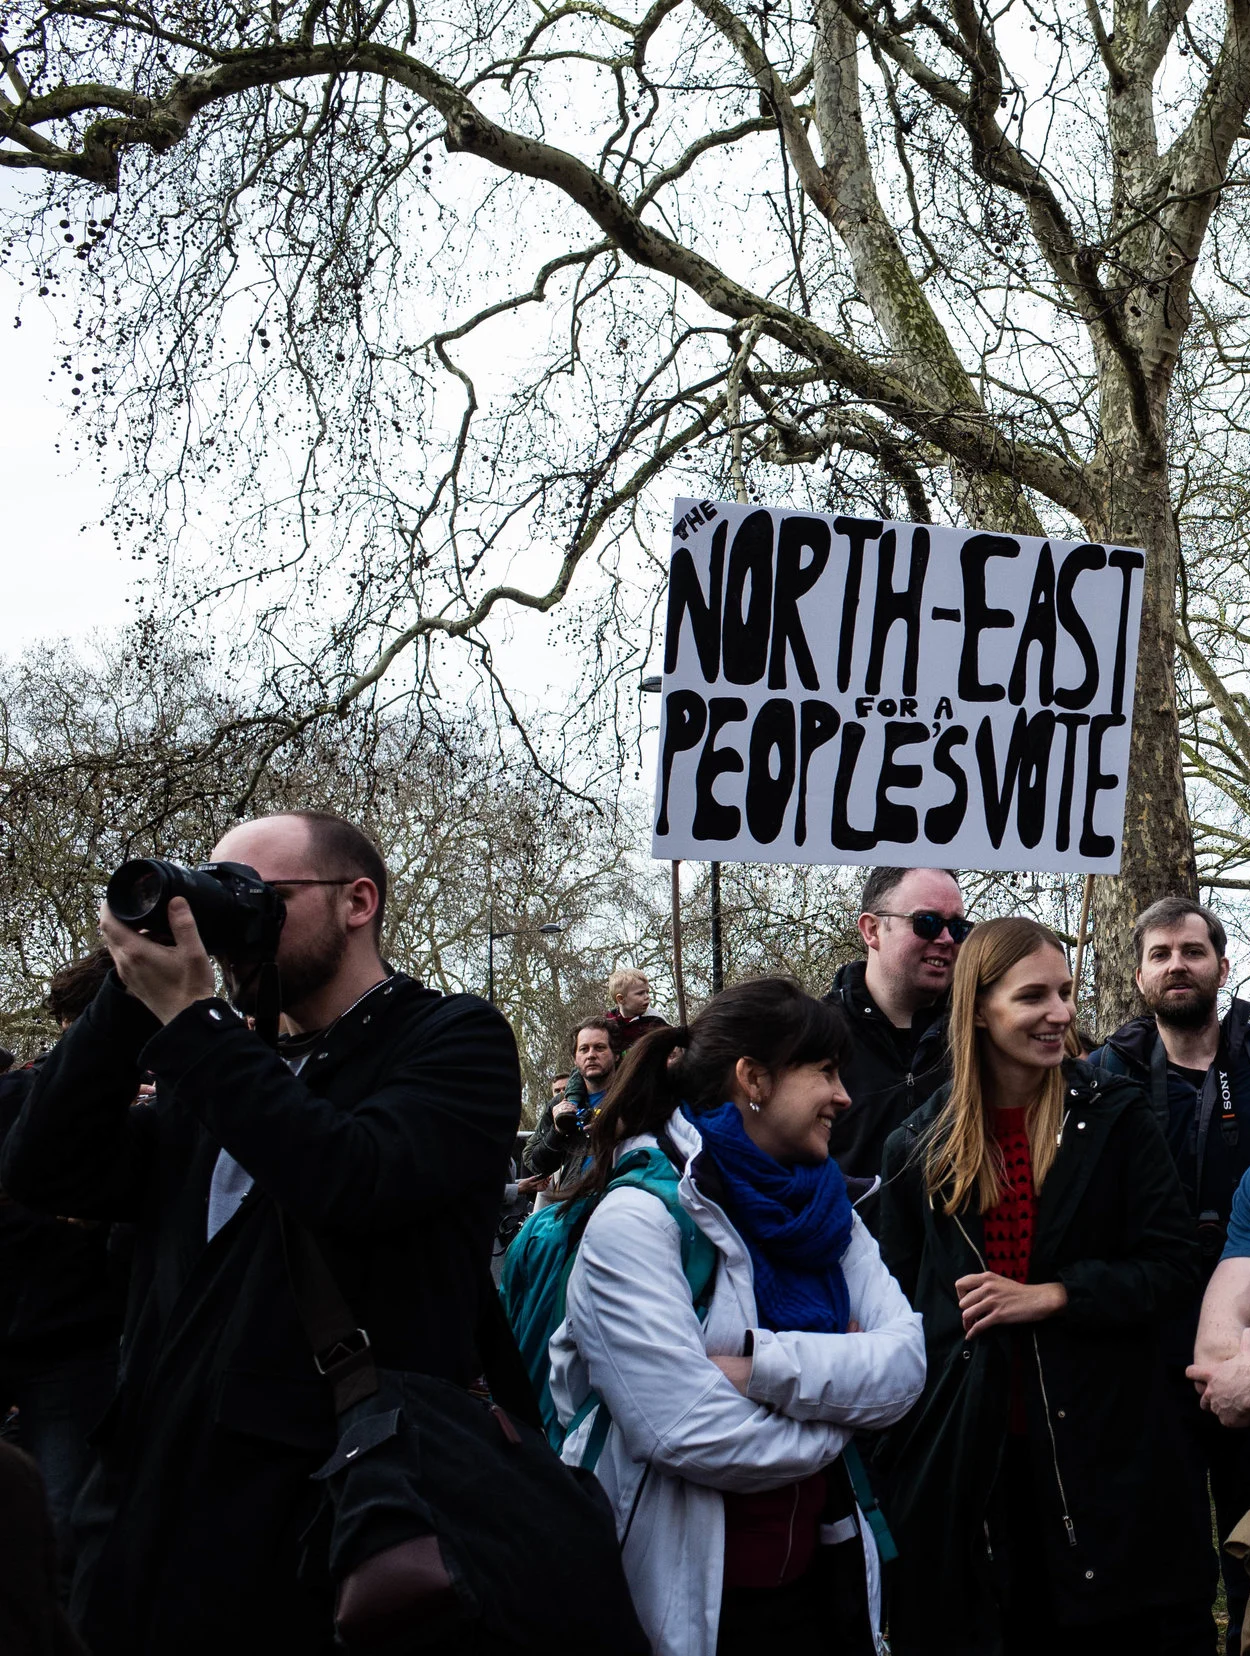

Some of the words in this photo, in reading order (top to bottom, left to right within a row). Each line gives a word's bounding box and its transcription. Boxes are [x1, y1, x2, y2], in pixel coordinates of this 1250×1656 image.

[672, 500, 717, 541] THE
[664, 509, 1144, 716] NORTH-EAST
[855, 697, 918, 719] FOR
[935, 697, 954, 720] A
[656, 690, 969, 851] PEOPLE'S
[975, 708, 1126, 858] VOTE
[1219, 1070, 1232, 1110] SONY
